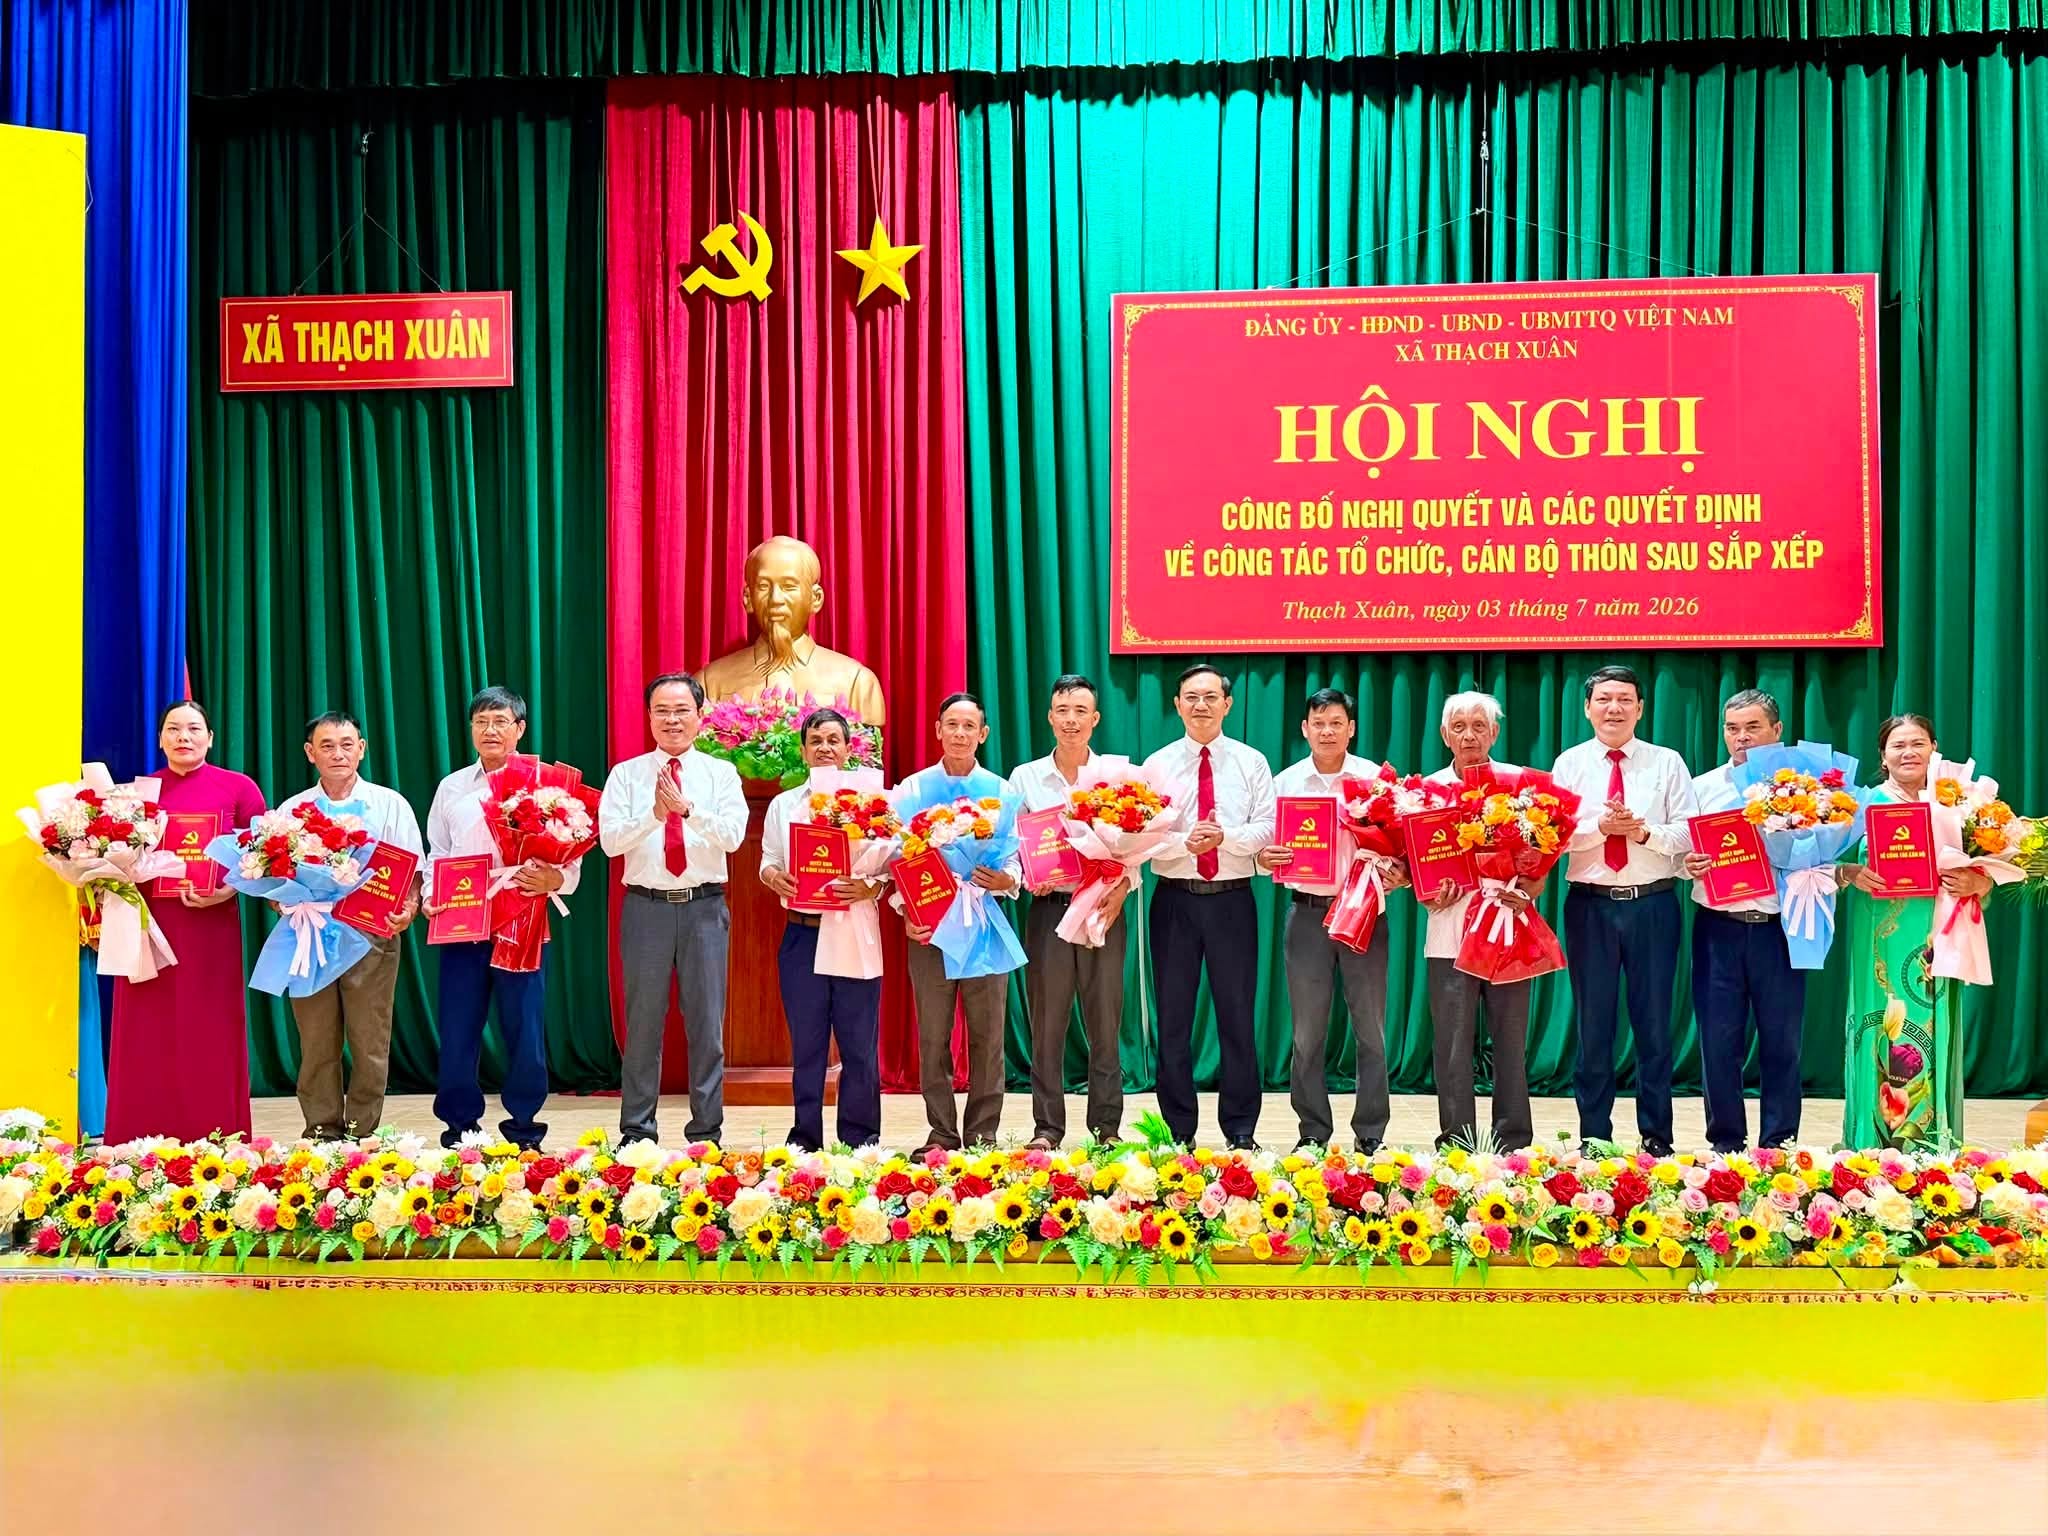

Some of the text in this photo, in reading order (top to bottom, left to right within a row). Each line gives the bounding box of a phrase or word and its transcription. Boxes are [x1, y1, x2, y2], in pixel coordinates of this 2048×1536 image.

[242, 309, 490, 371] XÃ THẠCH XUÂN
[1245, 313, 1307, 336] ĐẢNG
[1313, 312, 1343, 335] ỦY
[1360, 315, 1423, 334] HĐND
[1442, 312, 1503, 332] UBND
[1520, 309, 1617, 331] UBMTTQ
[1623, 303, 1676, 331] VIỆT
[1682, 307, 1734, 325] NAM
[1395, 335, 1578, 366] XÃ THẠCH XUÂN
[1273, 385, 1704, 479] HỘI NGHỊ
[1222, 486, 1762, 534] CÔNG BỐ NGHỊ QUYẾT VÀ CÁC QUYẾT ĐỊNH
[1164, 530, 1825, 578] VỀ CÔNG TÁC TỔ CHỨC, CÁN BỘ THÔN SAU SẮP XẾP
[1282, 597, 1699, 624] Thạch Xuân, ngày 03 tháng 7 năm 2026
